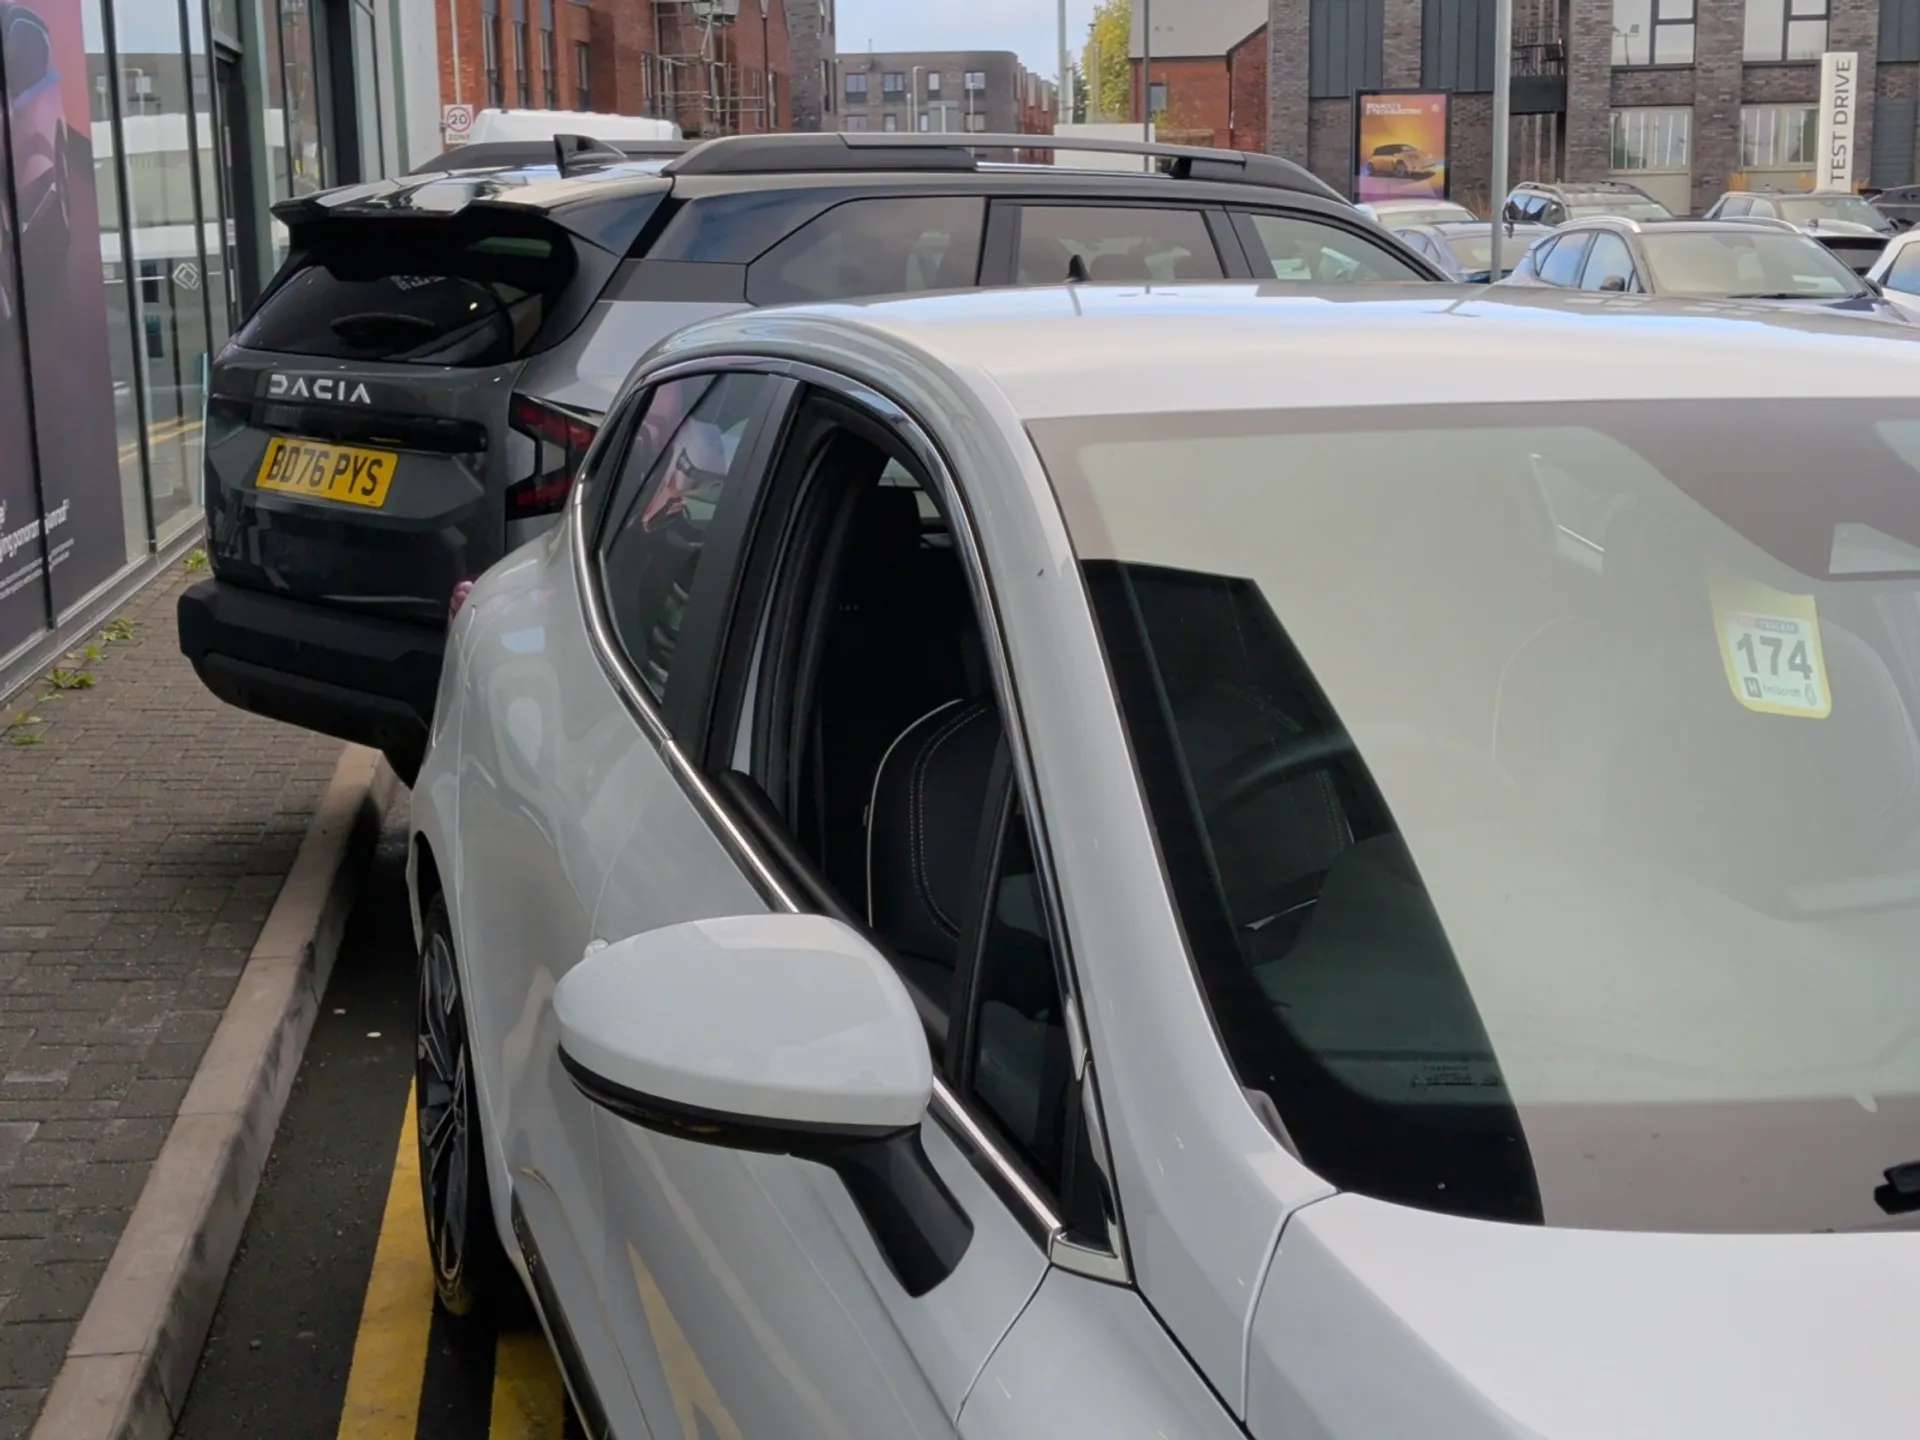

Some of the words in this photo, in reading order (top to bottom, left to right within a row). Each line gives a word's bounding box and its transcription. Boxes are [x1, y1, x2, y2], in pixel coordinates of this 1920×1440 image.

[1833, 58, 1852, 125] DRIVE
[449, 113, 468, 125] 20
[1831, 131, 1848, 184] TEST
[269, 374, 371, 404] DACIA
[266, 444, 329, 487] BD76
[328, 453, 383, 496] PYS
[1736, 633, 1813, 680] 174
